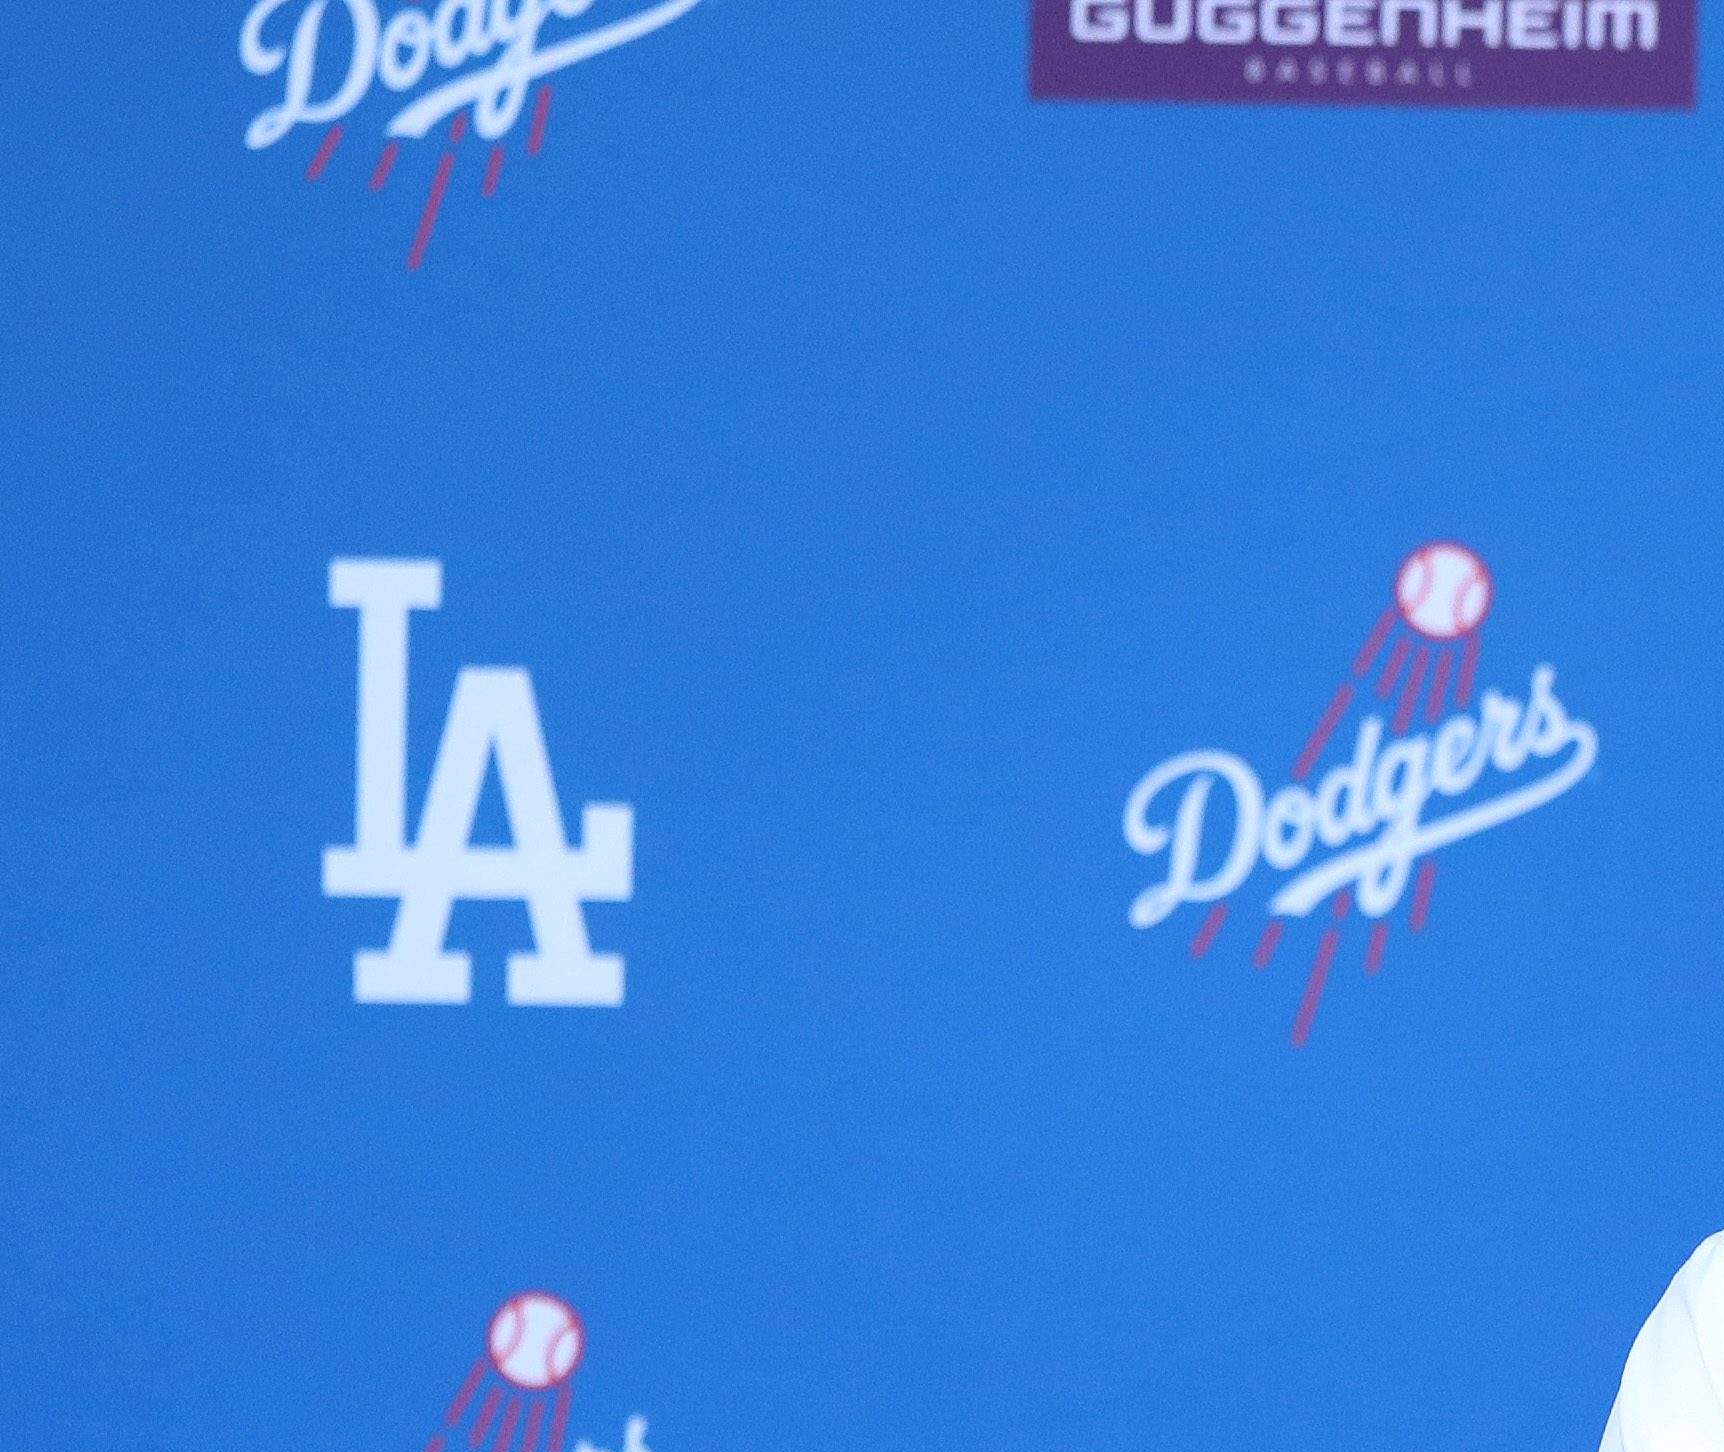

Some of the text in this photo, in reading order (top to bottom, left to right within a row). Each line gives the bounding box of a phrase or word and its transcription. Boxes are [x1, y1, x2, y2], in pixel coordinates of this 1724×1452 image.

[1069, 0, 1659, 50] GUGGENHEIM
[321, 557, 635, 1007] LA
[1122, 663, 1599, 930] Dodgers
